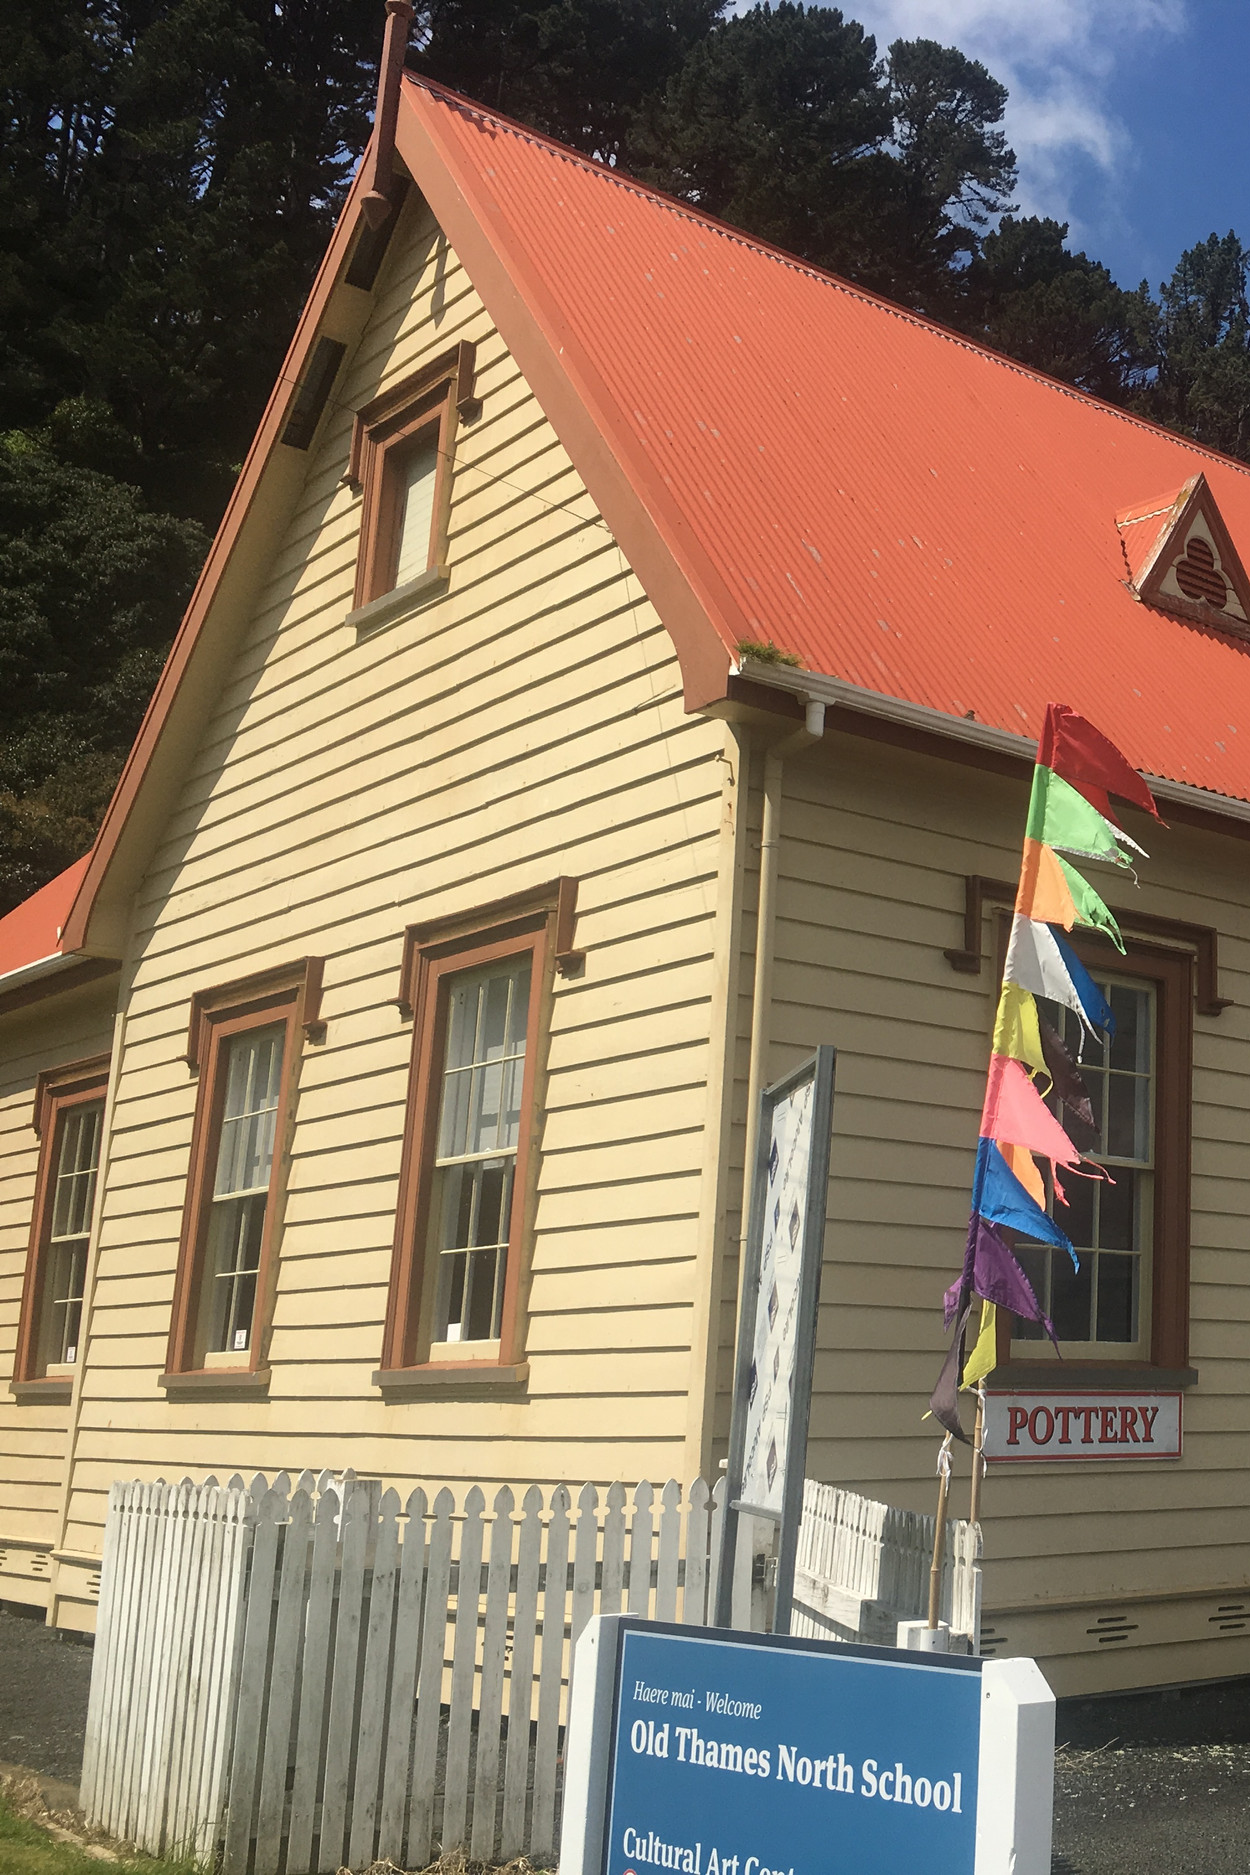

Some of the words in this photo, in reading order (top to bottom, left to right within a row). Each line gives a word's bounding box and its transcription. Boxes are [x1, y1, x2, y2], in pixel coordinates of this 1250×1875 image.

[1006, 1406, 1159, 1445] POTTERY
[632, 1681, 669, 1704] Haere
[671, 1689, 695, 1709] mai
[705, 1691, 762, 1720] Welcome
[631, 1719, 670, 1758] Old
[675, 1726, 771, 1778] Thames
[776, 1744, 855, 1793] North
[860, 1758, 963, 1814] School
[623, 1827, 701, 1875] Cultural
[705, 1847, 740, 1875] Art
